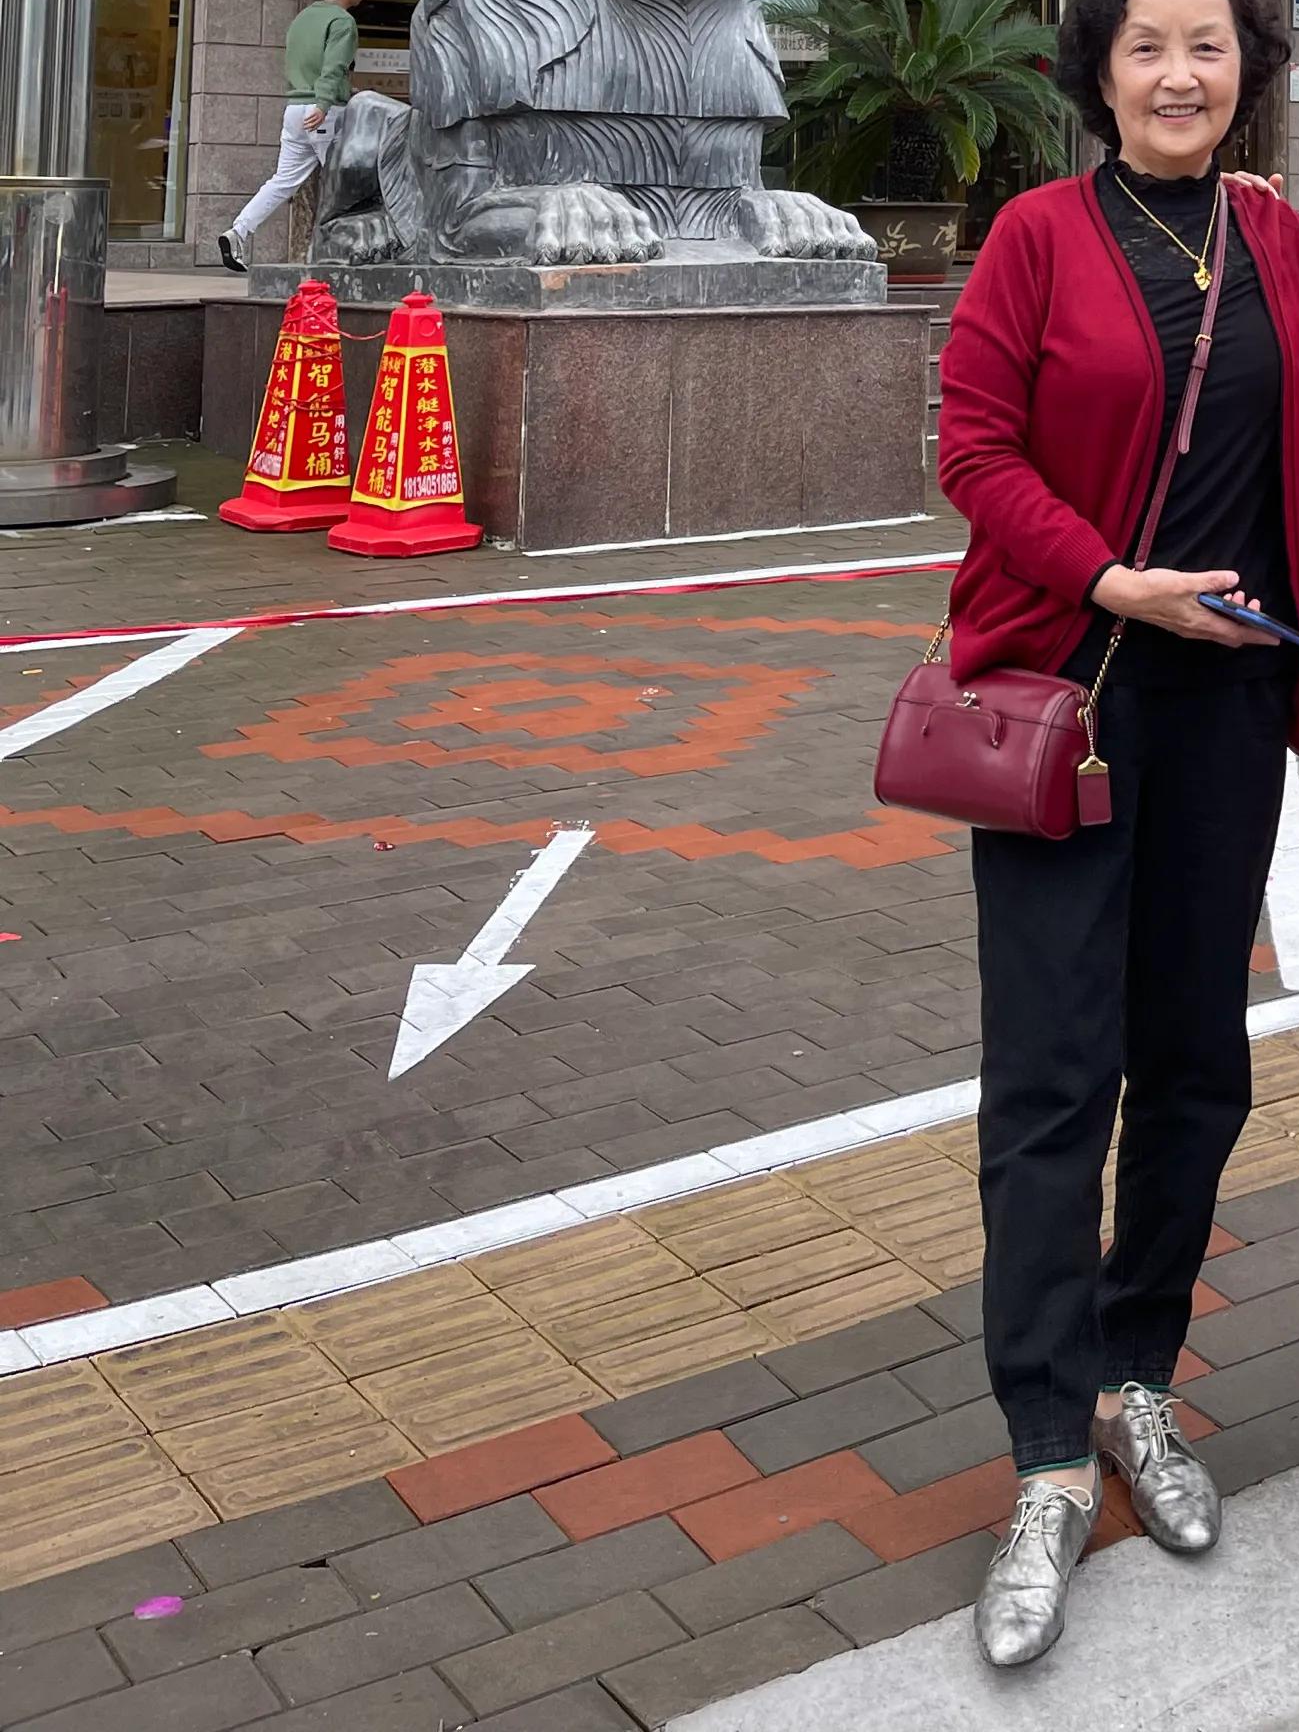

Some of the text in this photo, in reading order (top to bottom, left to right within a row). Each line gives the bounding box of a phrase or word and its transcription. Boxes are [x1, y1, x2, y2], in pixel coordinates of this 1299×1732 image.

[305, 363, 334, 477] 智能马桶
[368, 375, 398, 495] 智能马桶
[415, 357, 440, 473] 潜水艇净水器
[441, 421, 454, 470] 用的安心
